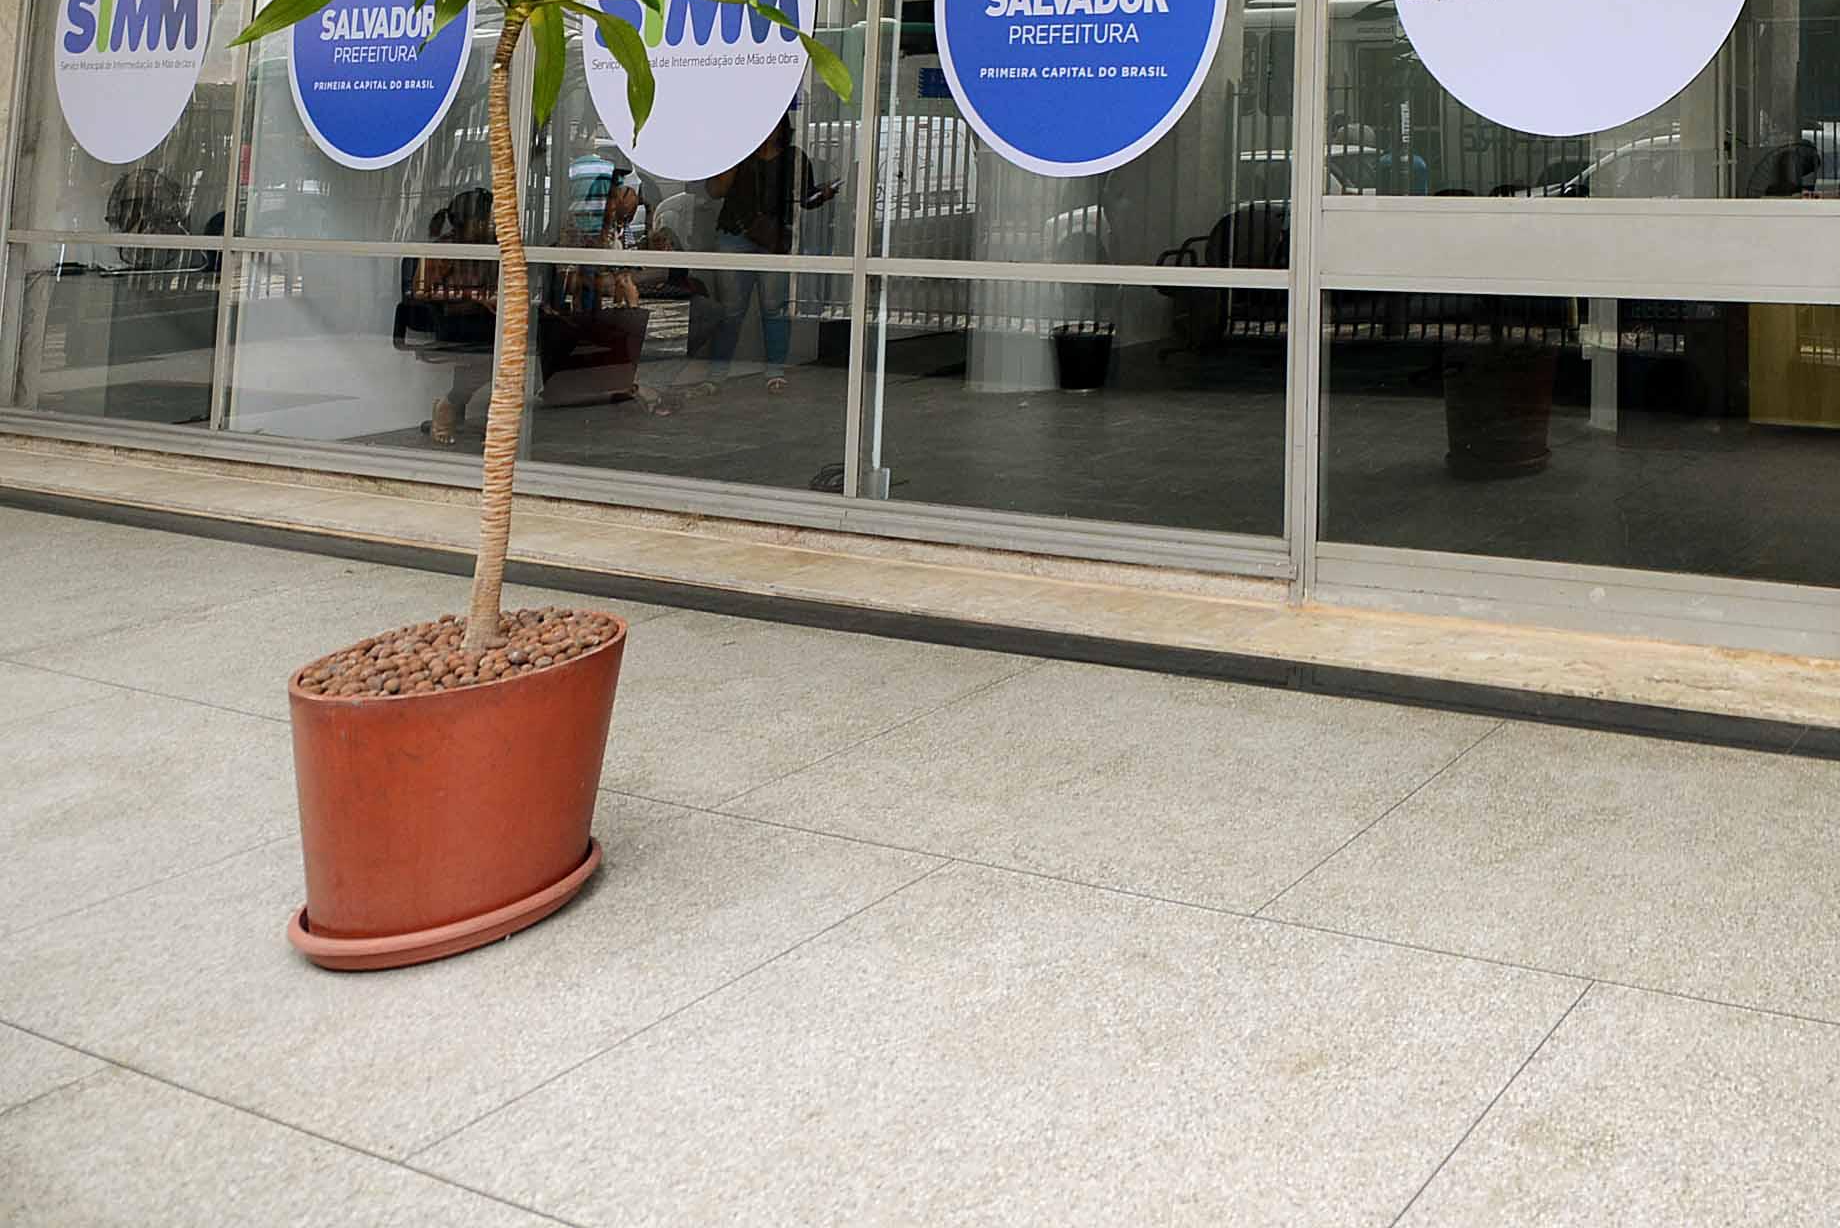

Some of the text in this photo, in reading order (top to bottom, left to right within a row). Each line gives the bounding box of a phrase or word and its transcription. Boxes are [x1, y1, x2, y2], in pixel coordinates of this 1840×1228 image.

[320, 5, 436, 41] SALVADOR
[1008, 22, 1140, 45] PREFEITURA
[334, 44, 418, 63] PREFEITURA
[660, 55, 670, 68] de
[672, 52, 734, 69] Intermediação
[735, 53, 746, 65] de
[747, 52, 765, 65] Mão
[767, 52, 777, 64] de
[778, 52, 800, 64] Obra
[979, 65, 1168, 79] PRIMEIRA CAPITAL DO BRASIL
[314, 79, 435, 91] PRIMEIRA CAPITAL DO BRASIL
